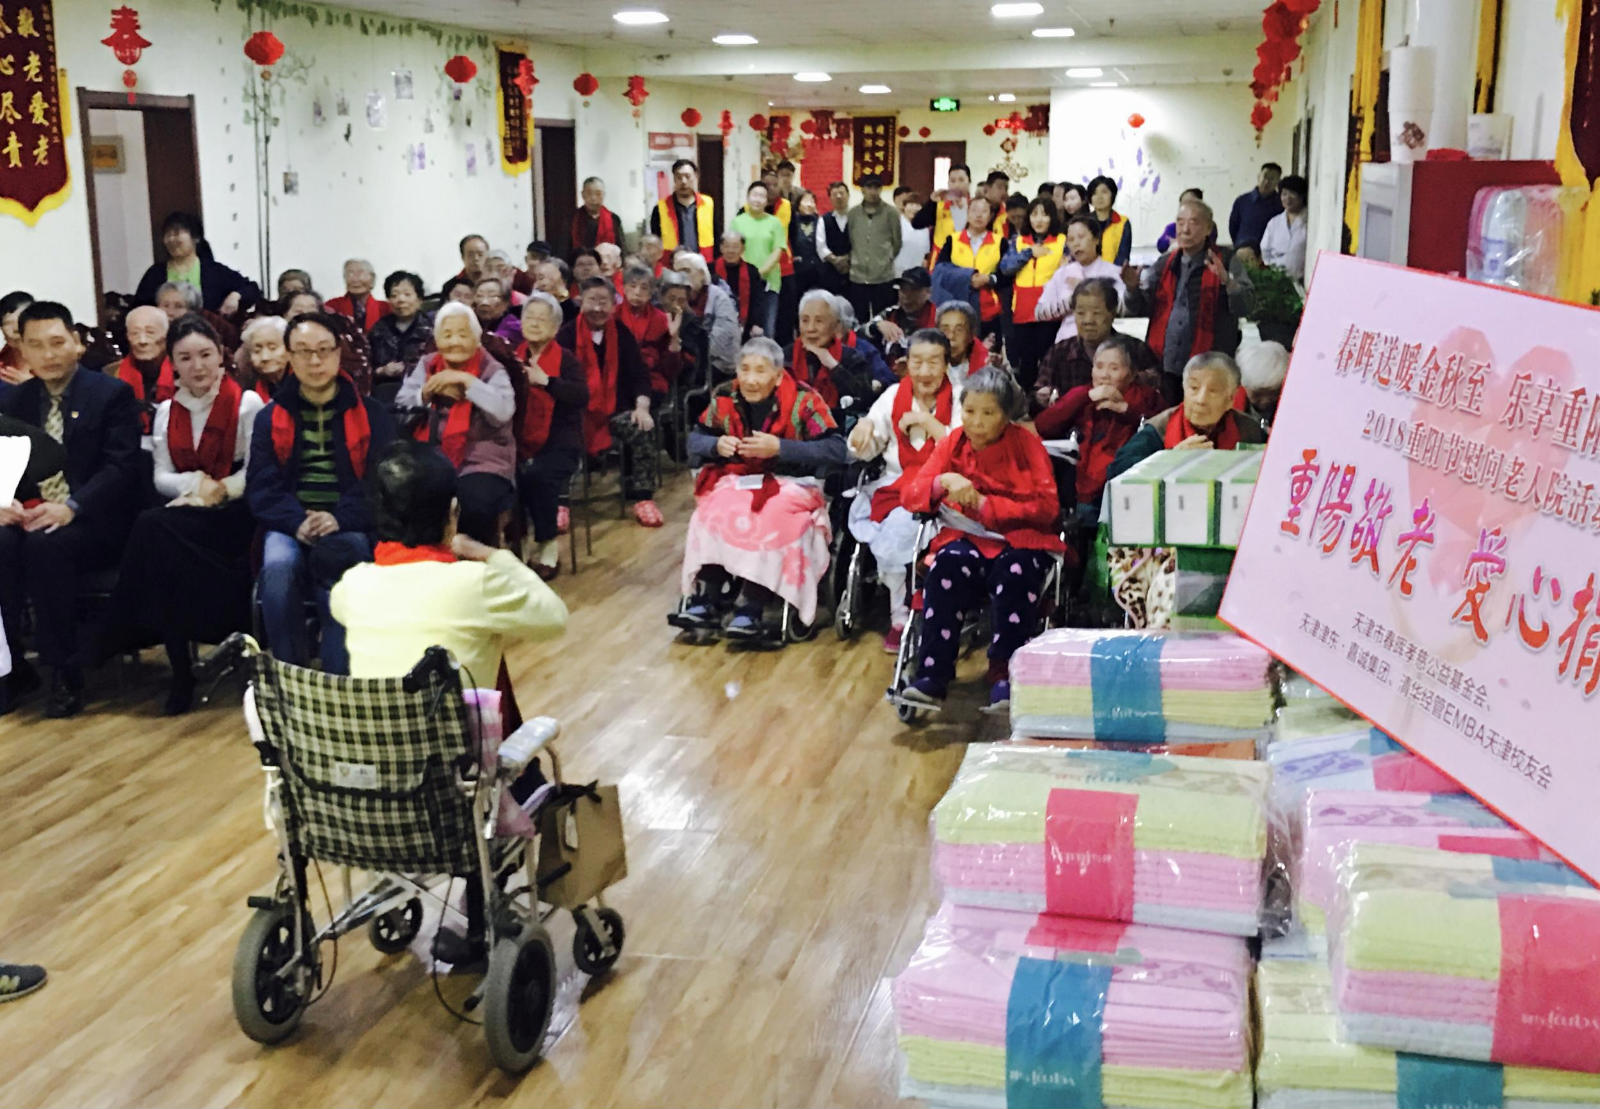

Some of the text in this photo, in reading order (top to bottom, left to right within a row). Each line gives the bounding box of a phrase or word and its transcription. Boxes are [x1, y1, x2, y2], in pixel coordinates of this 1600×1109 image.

[1336, 323, 1491, 413] 春晖送暖金秋至
